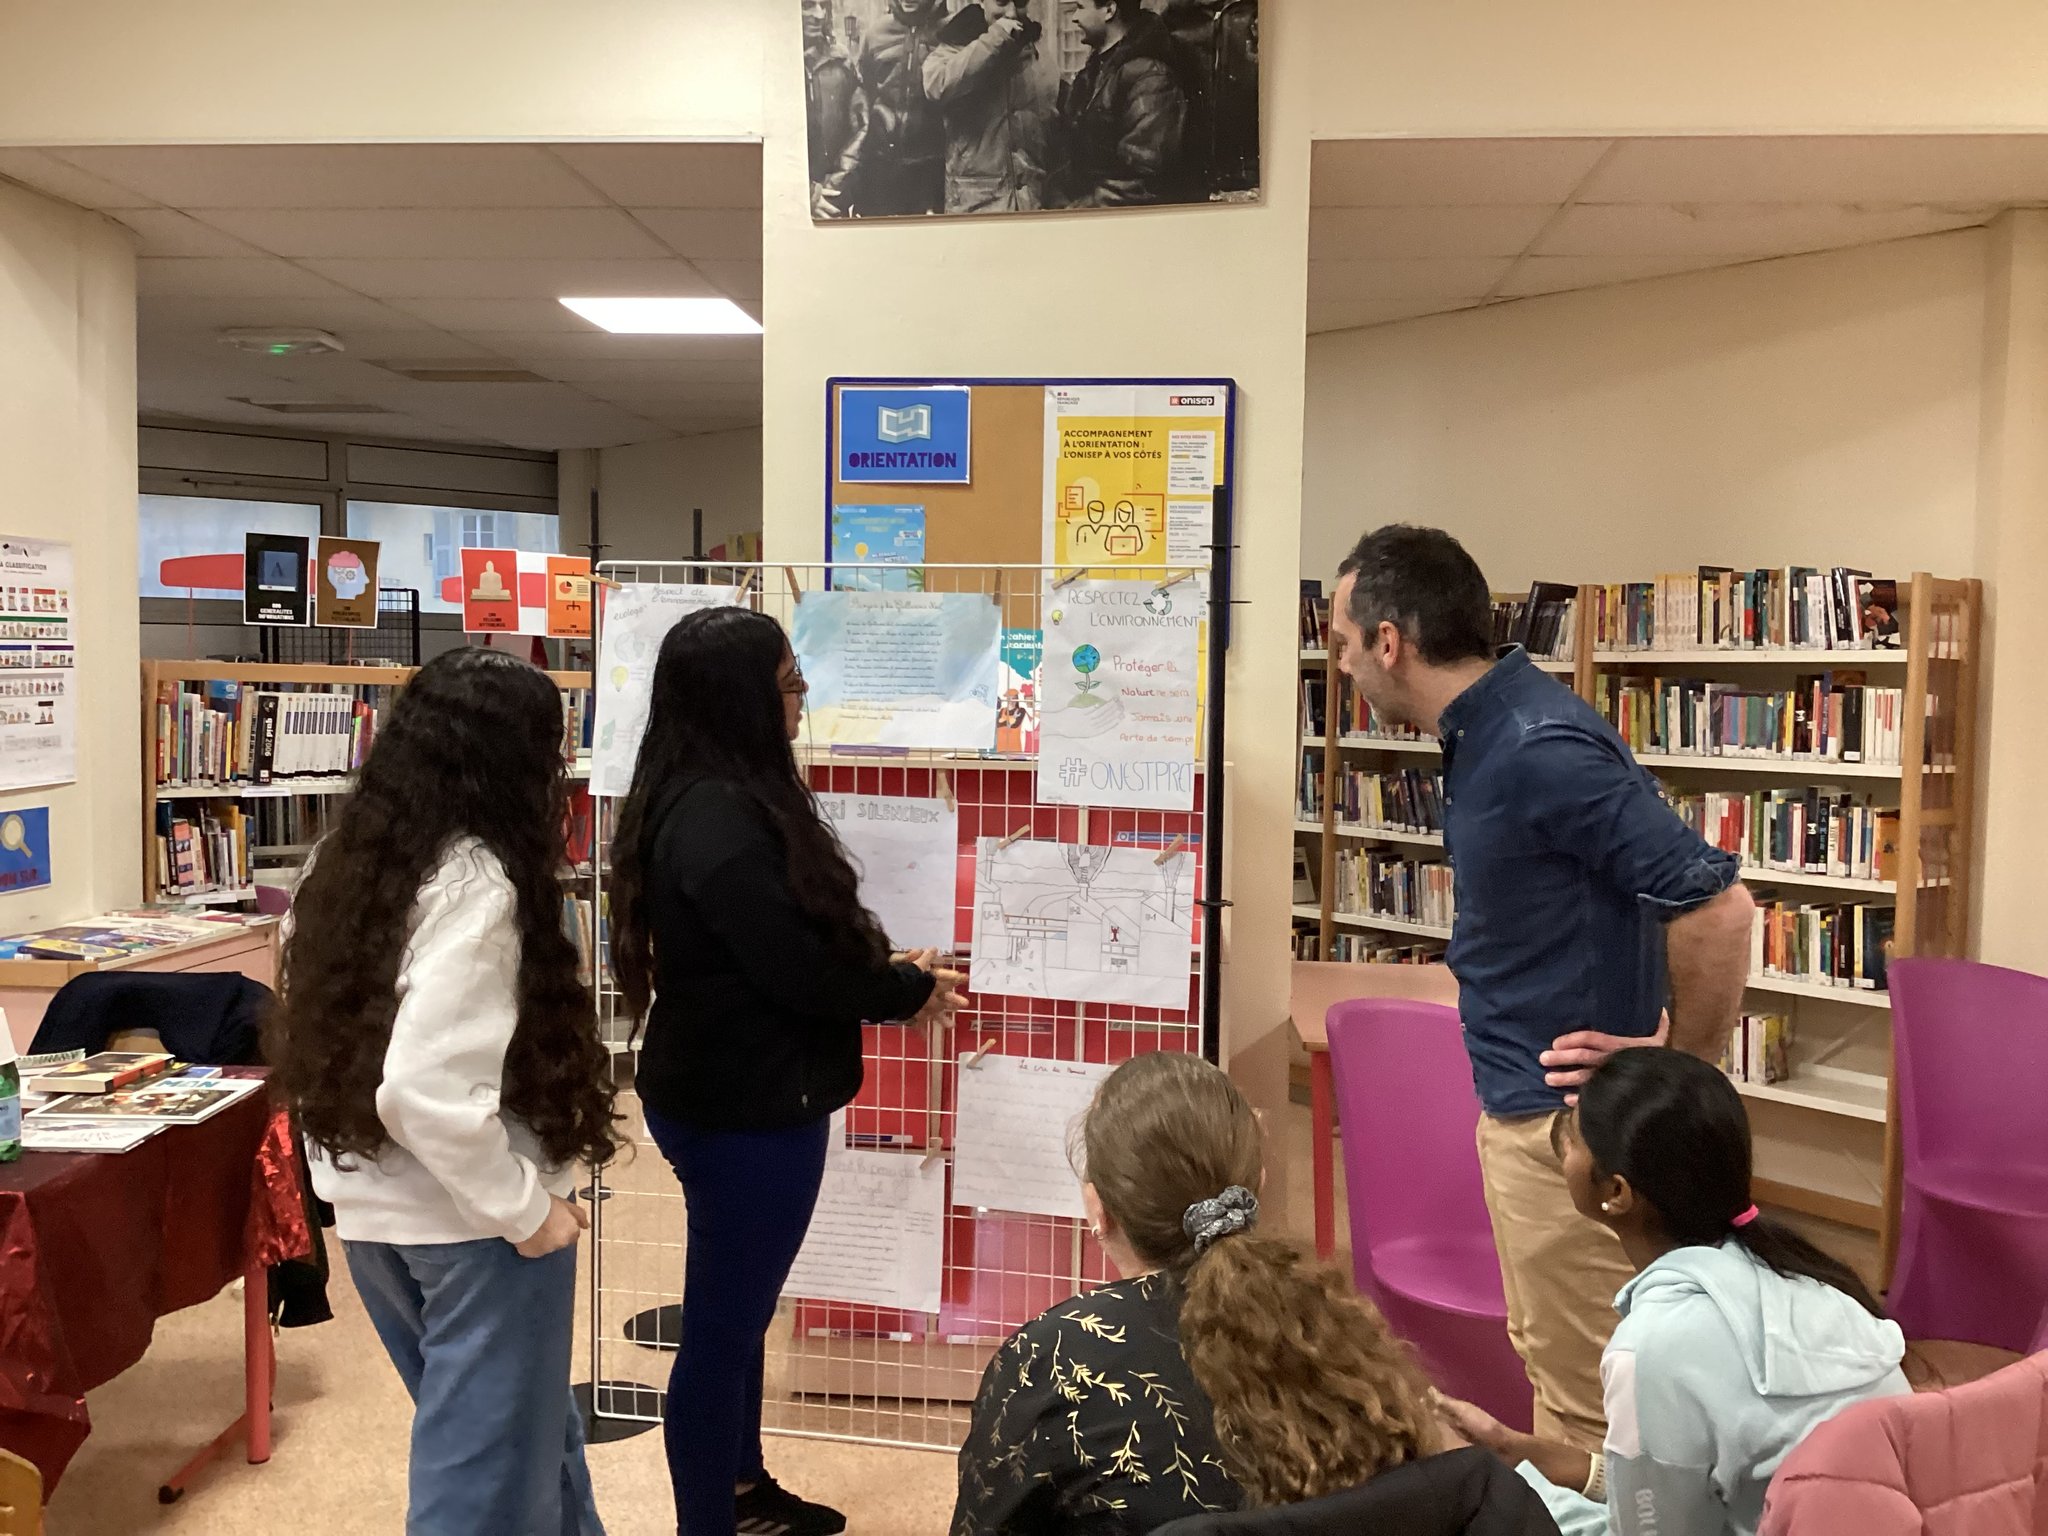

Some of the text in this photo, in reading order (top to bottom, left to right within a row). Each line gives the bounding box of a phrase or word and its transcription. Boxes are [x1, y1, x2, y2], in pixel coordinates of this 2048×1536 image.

[1181, 397, 1213, 406] onisep
[1064, 430, 1153, 438] ACCOMPAGNEMENT
[1063, 440, 1071, 448] À
[1072, 440, 1140, 448] L'ORIENTATION
[1063, 451, 1103, 459] L'ONISEP
[1104, 450, 1112, 459] À
[1113, 451, 1131, 459] VOS
[1133, 449, 1162, 459] CÔTÉS
[848, 452, 956, 468] ORIENTATION
[5, 561, 47, 570] CLASSIFICATION
[1068, 589, 1142, 606] RESPECTEZ
[1091, 612, 1200, 628] L'ENVIRONNEMENT
[1008, 633, 1037, 641] cahier
[1113, 655, 1164, 677] Protéger
[1121, 687, 1156, 697] Nature
[1146, 734, 1158, 742] de
[857, 801, 940, 824] SILENCIEUX
[983, 910, 1001, 921] U-3
